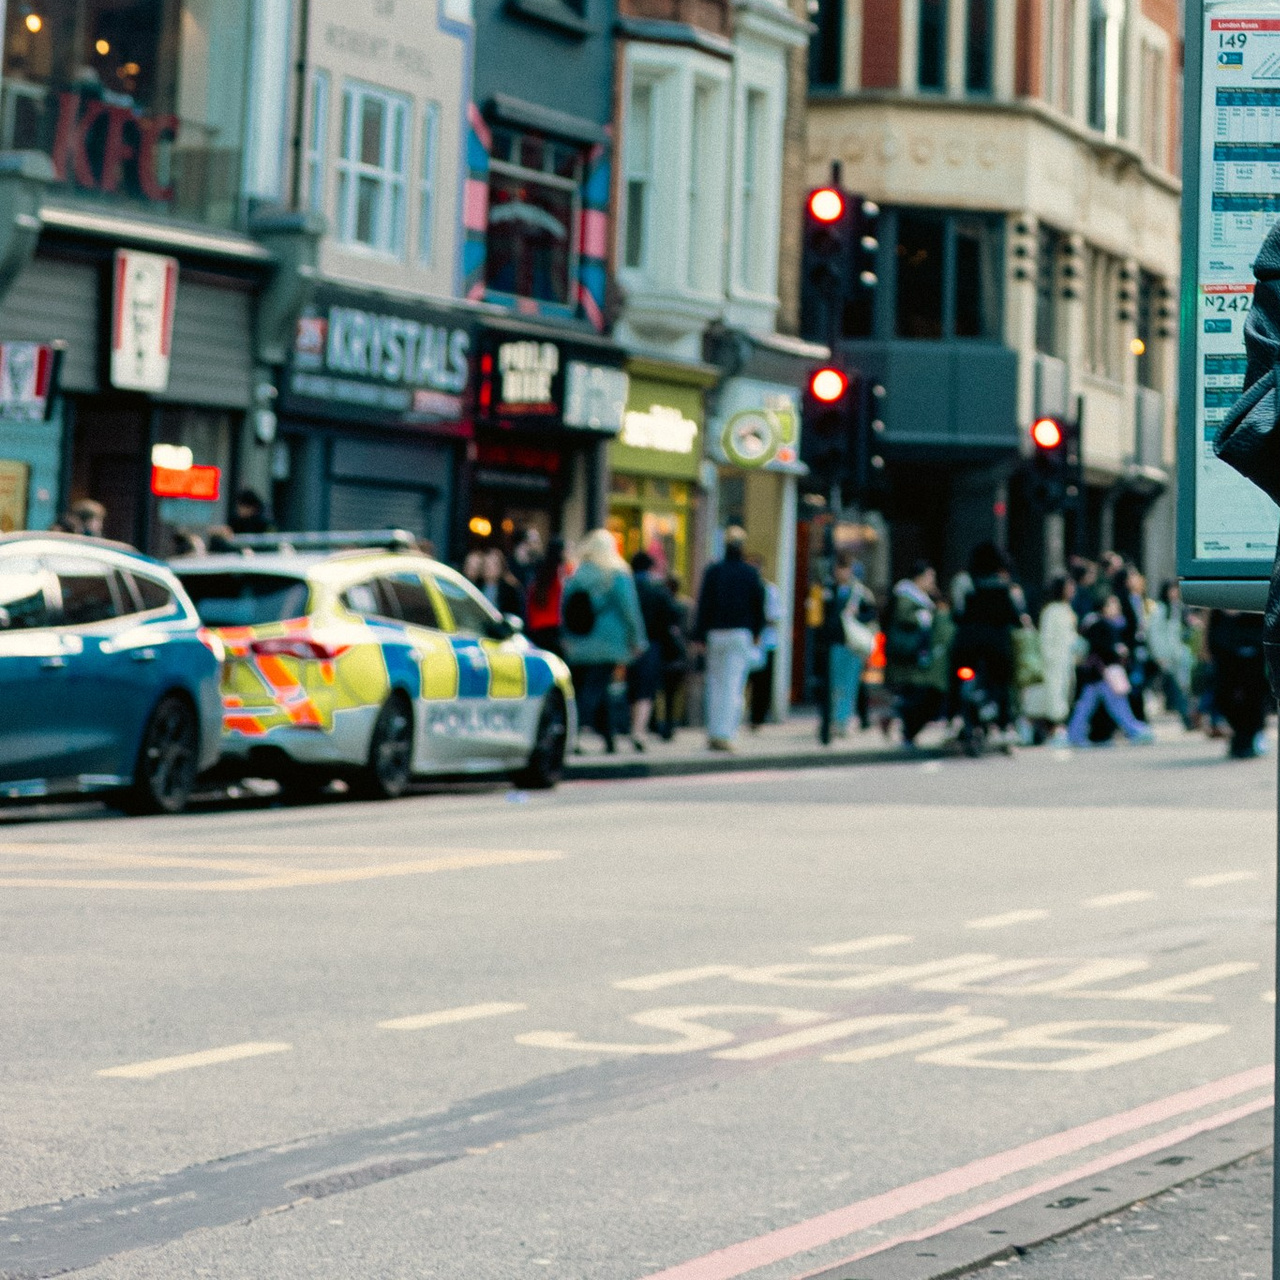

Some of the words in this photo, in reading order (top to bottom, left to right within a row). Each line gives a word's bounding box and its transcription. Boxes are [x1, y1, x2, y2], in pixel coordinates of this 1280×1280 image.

[1218, 33, 1247, 49] 149
[50, 92, 179, 202] KFC
[1205, 295, 1249, 312] N242
[327, 305, 470, 395] KRYSTALS
[513, 1003, 1232, 1072] BUS
